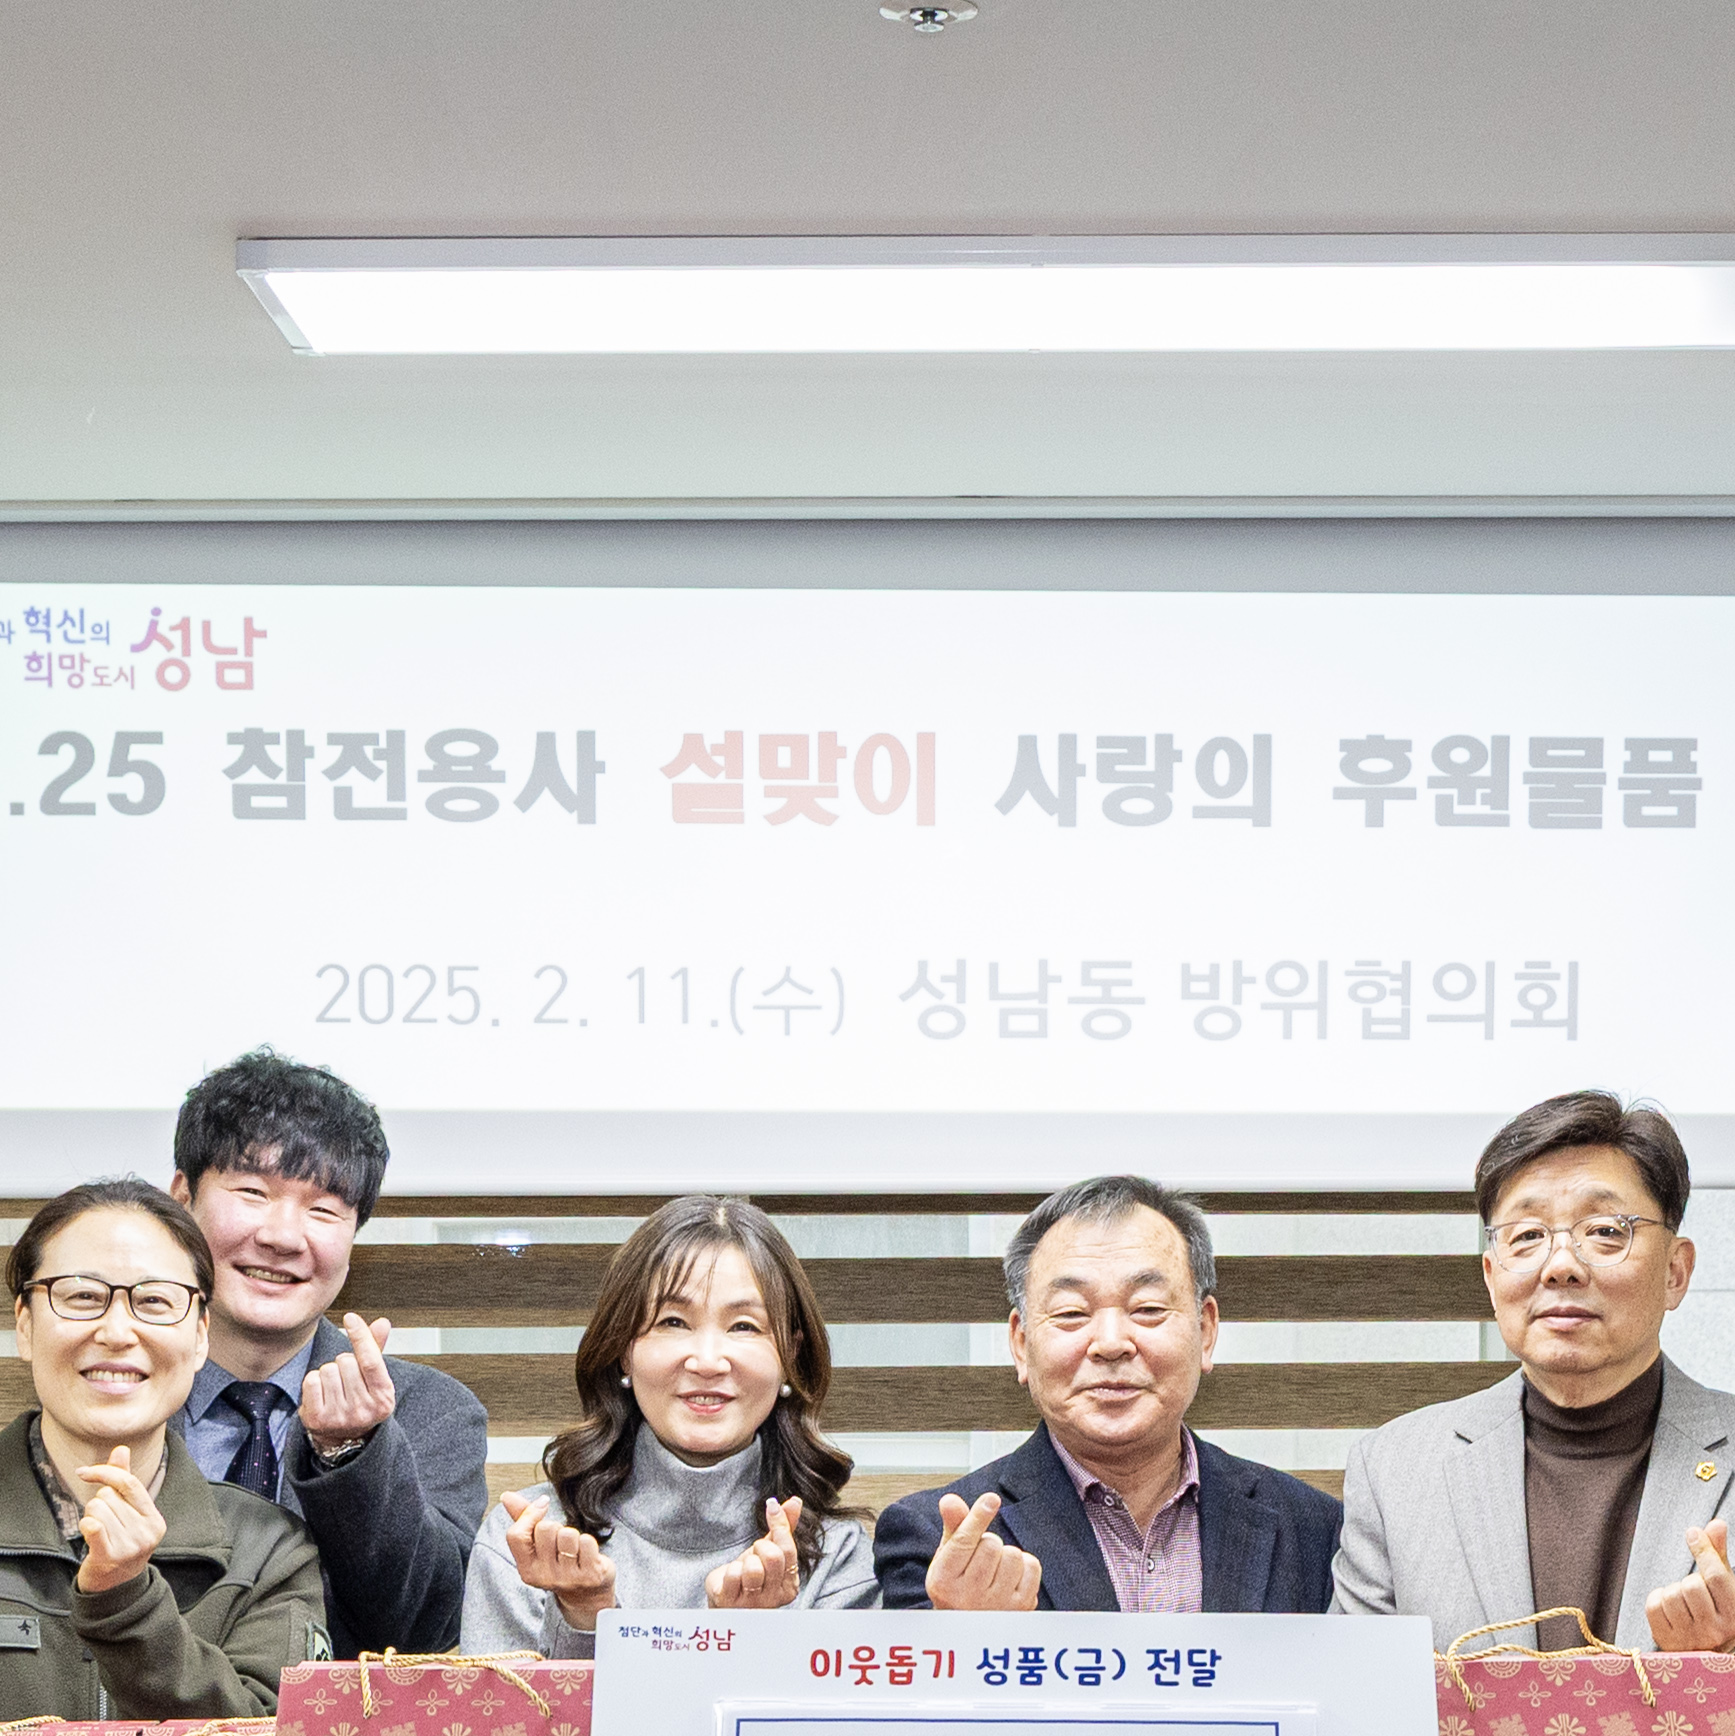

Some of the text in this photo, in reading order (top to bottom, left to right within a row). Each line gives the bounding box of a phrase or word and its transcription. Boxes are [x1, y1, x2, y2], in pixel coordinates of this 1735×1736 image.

[23, 606, 110, 645] 혁신의
[130, 607, 267, 691] 성남
[24, 651, 135, 690] 희망도시
[221, 727, 606, 826] 참전용사
[659, 731, 937, 827] 설맞이
[994, 733, 1273, 829] 사랑의
[1332, 733, 1702, 831] 후원물품
[314, 957, 1581, 1041] 2025. 2. 11.(수) 성남동 방위협의회
[618, 1626, 682, 1638] 첨단과 혁신의
[651, 1639, 690, 1651] 희망도시
[688, 1626, 736, 1651] 성남
[810, 1647, 1222, 1687] 이웃돕기 성품(금) 전달
